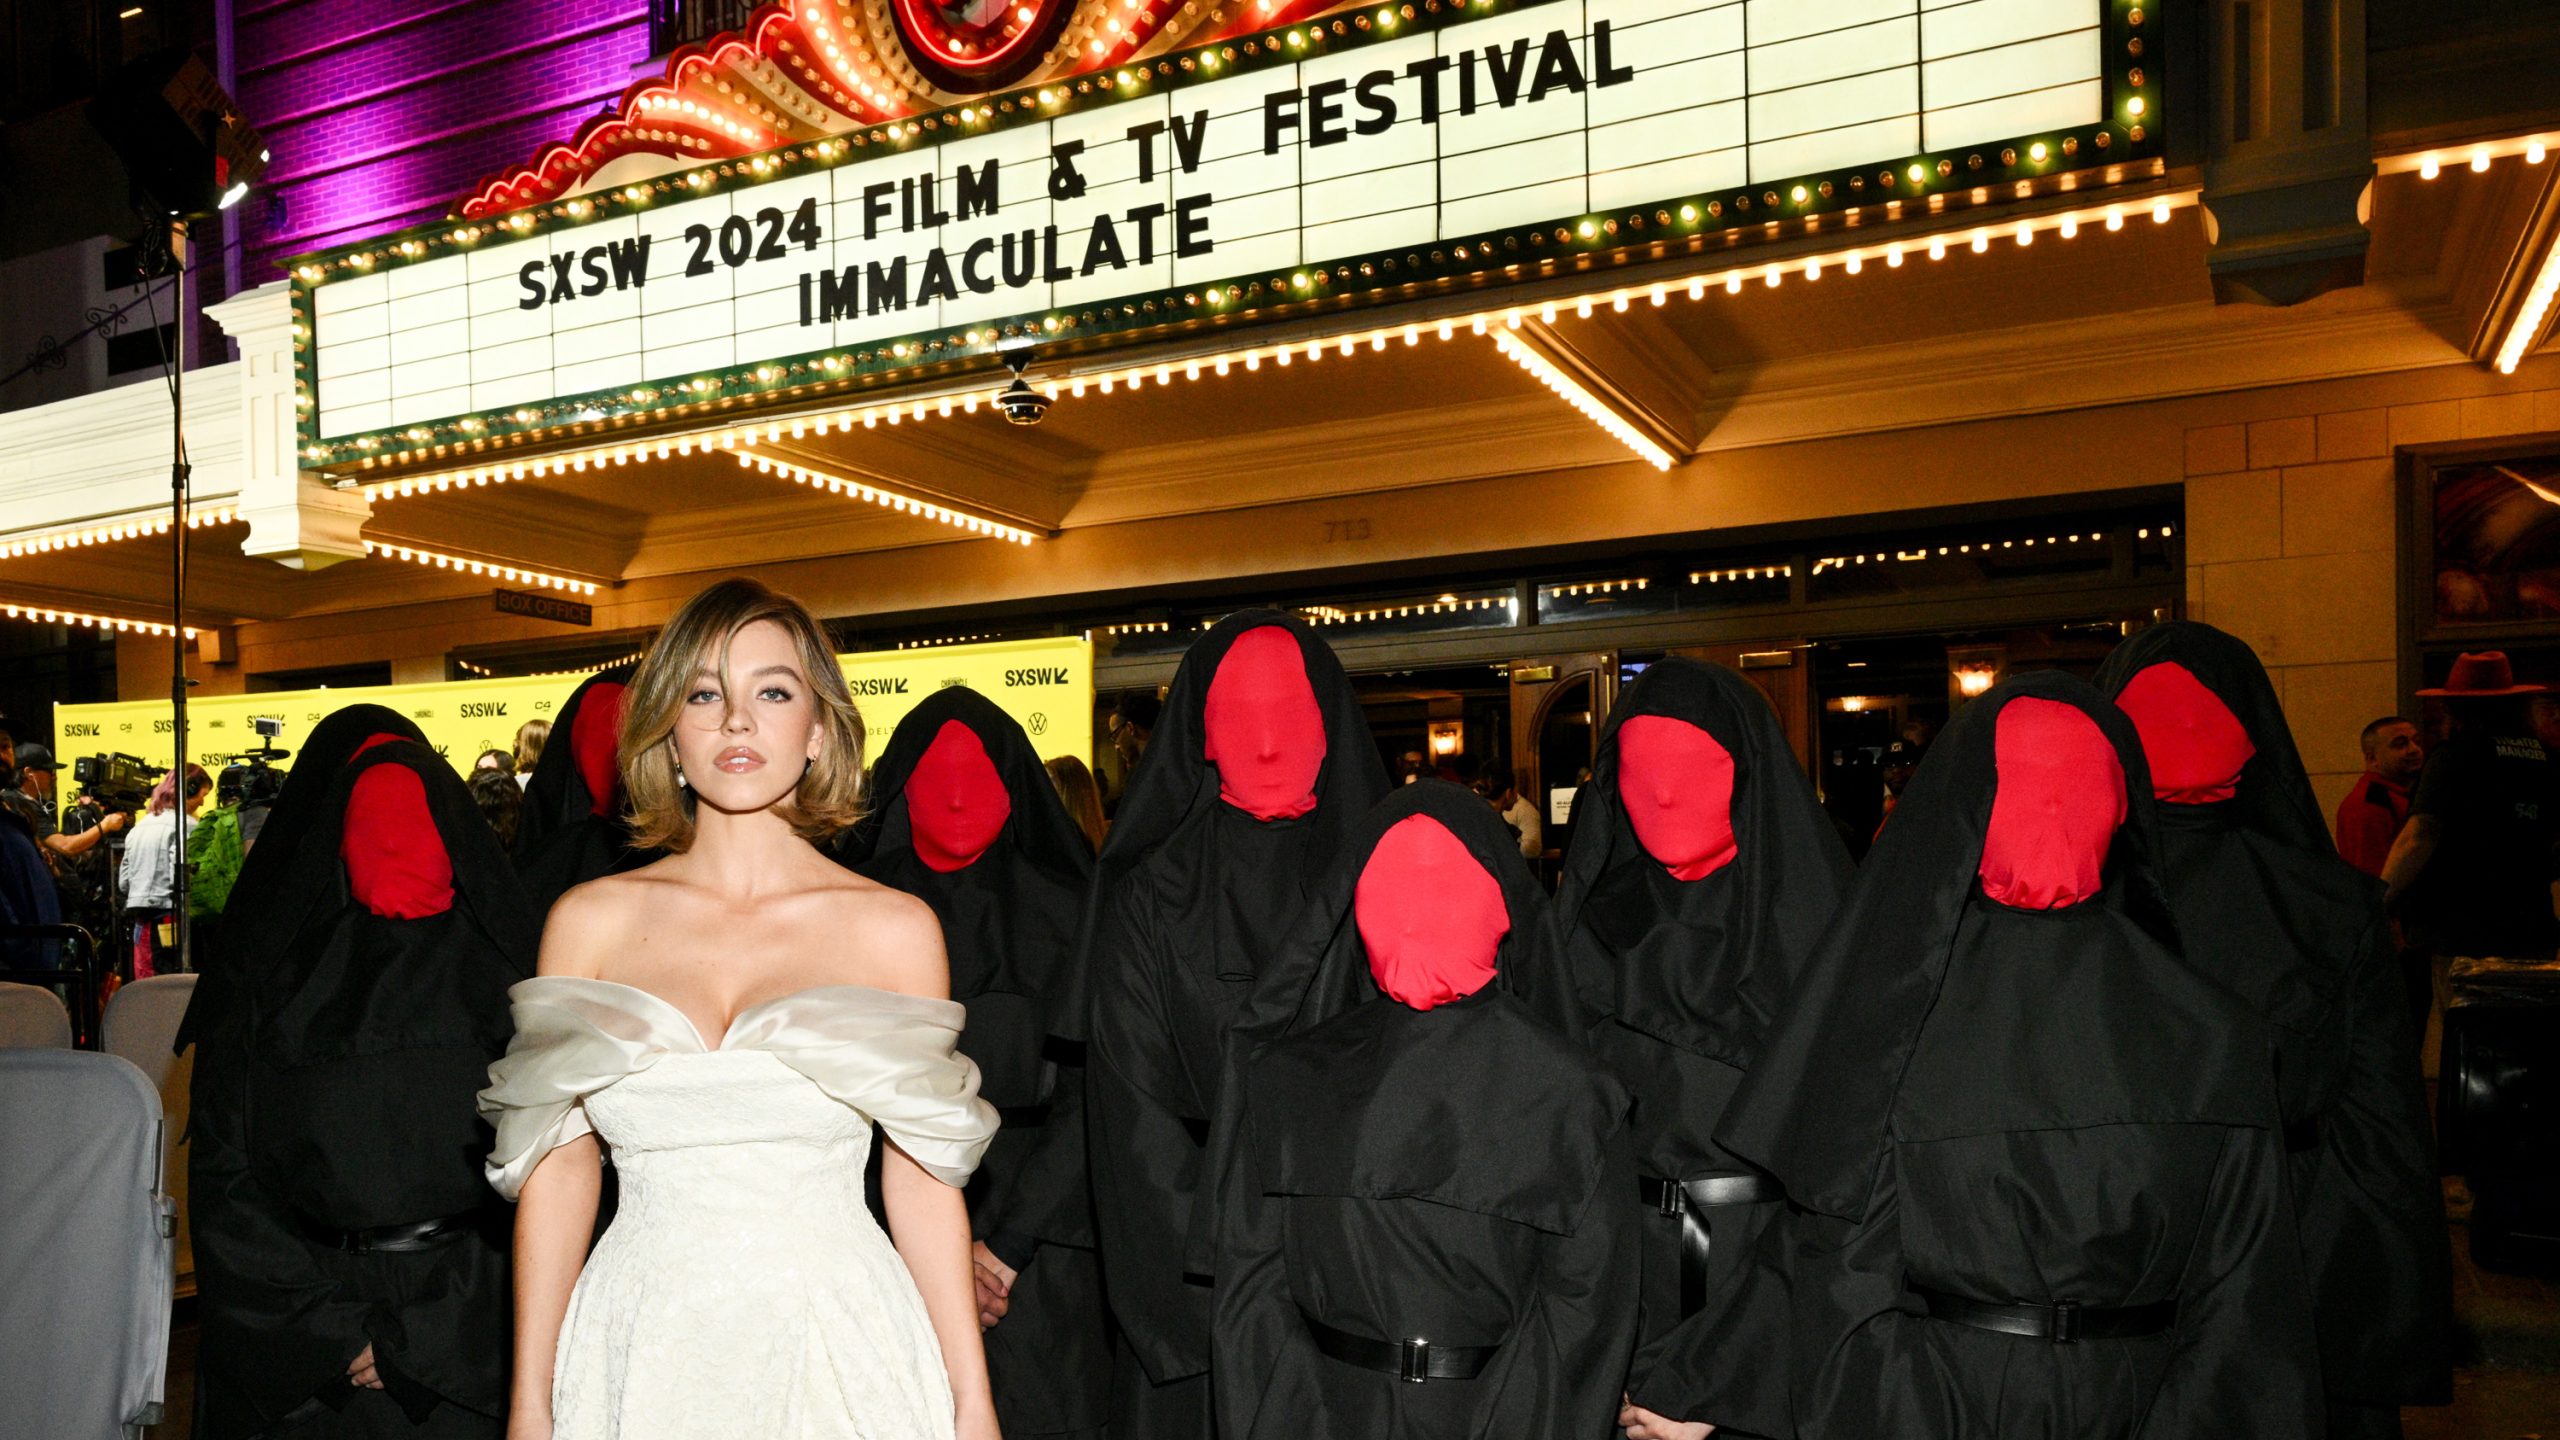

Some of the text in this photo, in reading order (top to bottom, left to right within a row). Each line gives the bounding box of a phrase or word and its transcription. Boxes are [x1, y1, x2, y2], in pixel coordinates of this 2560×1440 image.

[519, 19, 1634, 311] SXSW 2024 FILM & TV FESTIVAL
[799, 192, 1214, 327] IMMACULATE
[499, 593, 590, 620] BOX OFFICE
[1005, 668, 1052, 687] SXSW
[850, 679, 893, 696] SXSW
[460, 702, 495, 718] SXSW
[65, 723, 93, 737] SXSW
